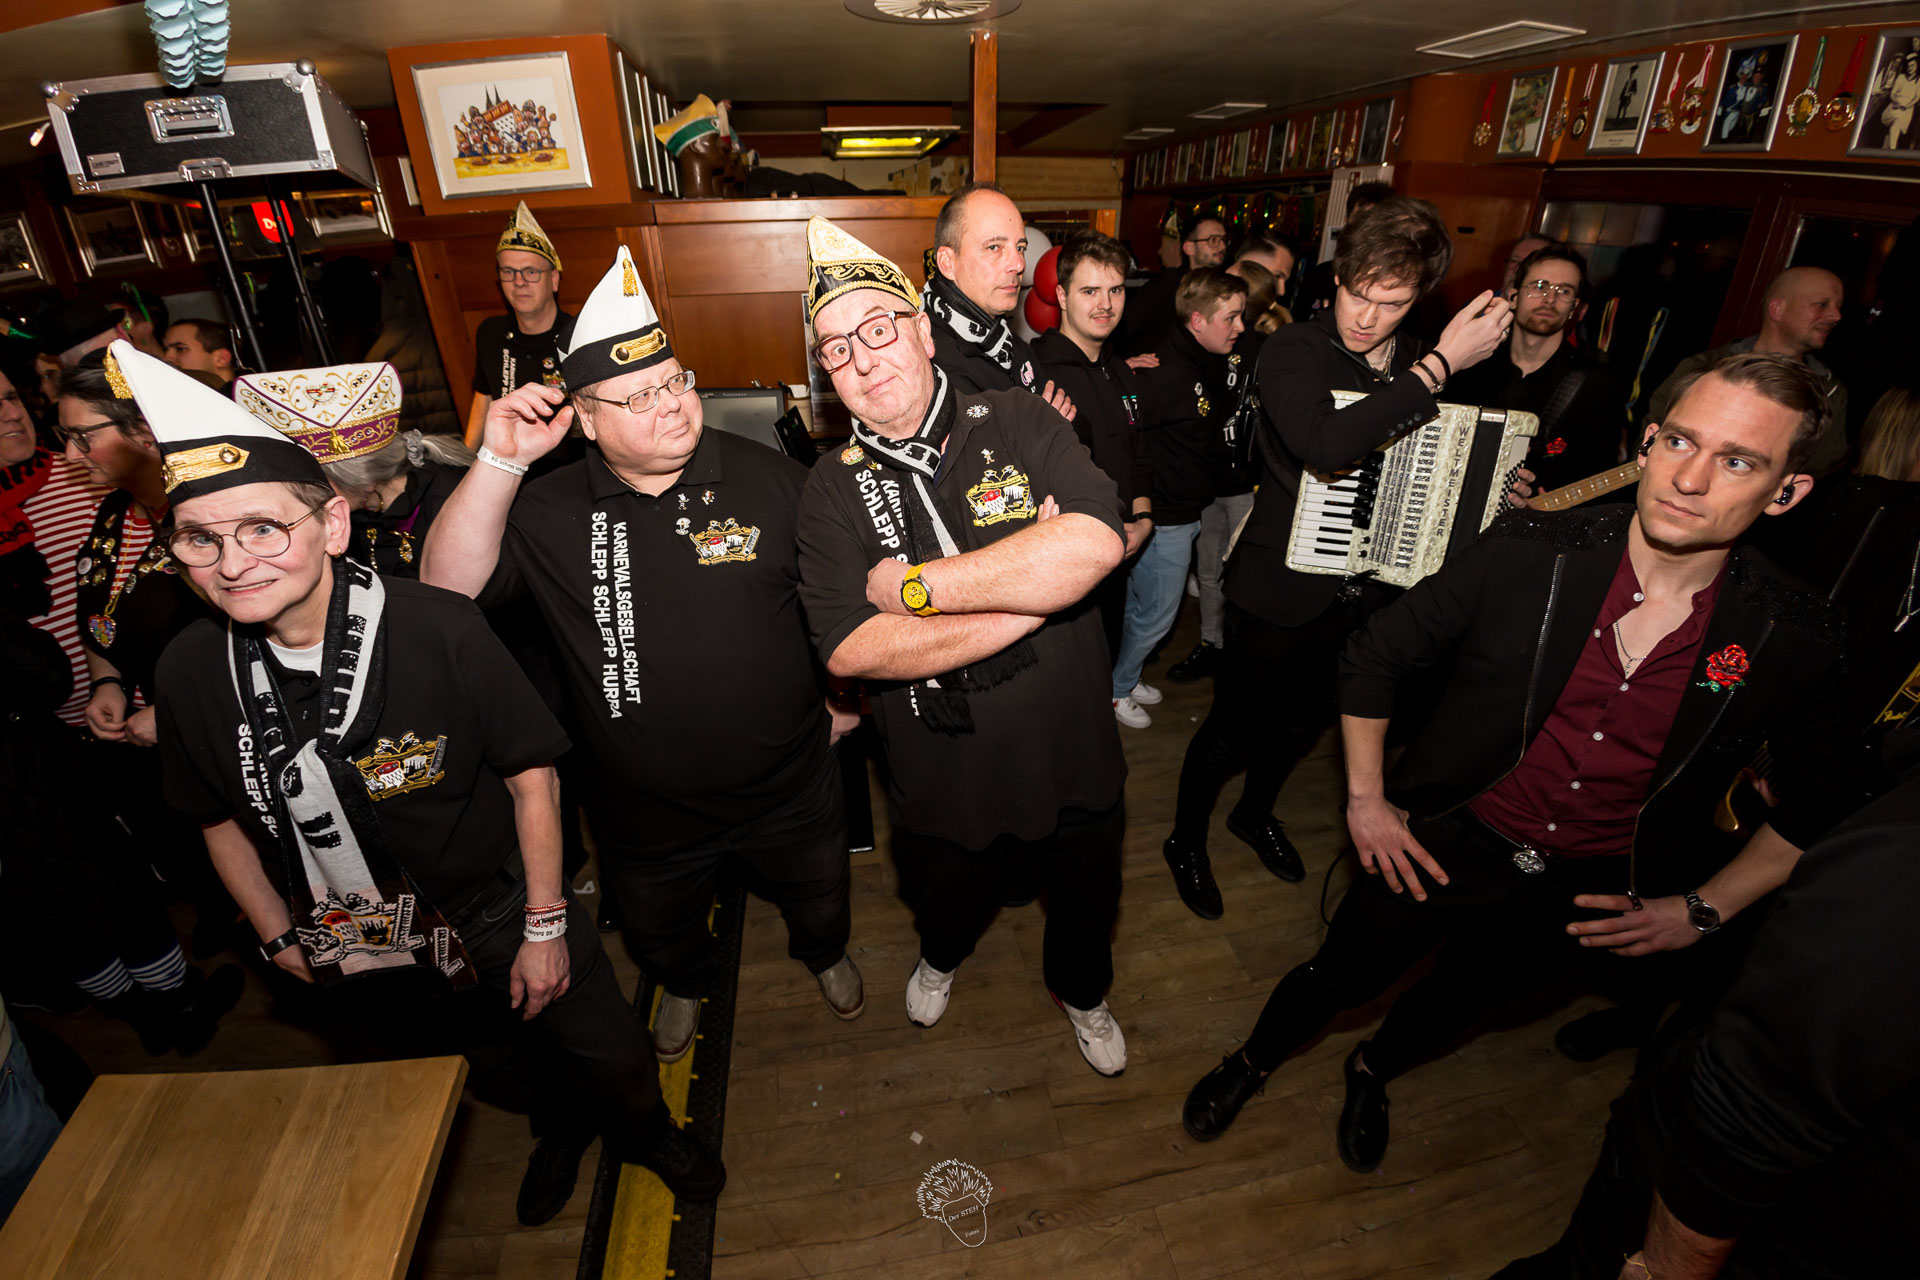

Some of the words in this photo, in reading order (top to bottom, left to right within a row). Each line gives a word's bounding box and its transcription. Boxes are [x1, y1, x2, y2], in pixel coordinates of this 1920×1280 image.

[855, 469, 901, 549] SCHLEPP
[1436, 426, 1471, 536] WELTMEISTER
[591, 511, 608, 580] SCHLEPP
[592, 585, 618, 658] SCHLEPP
[613, 521, 642, 704] KARNEVALSGESELLSCHAFT
[602, 664, 623, 719] HURRA
[238, 723, 269, 812] SCHLEPP
